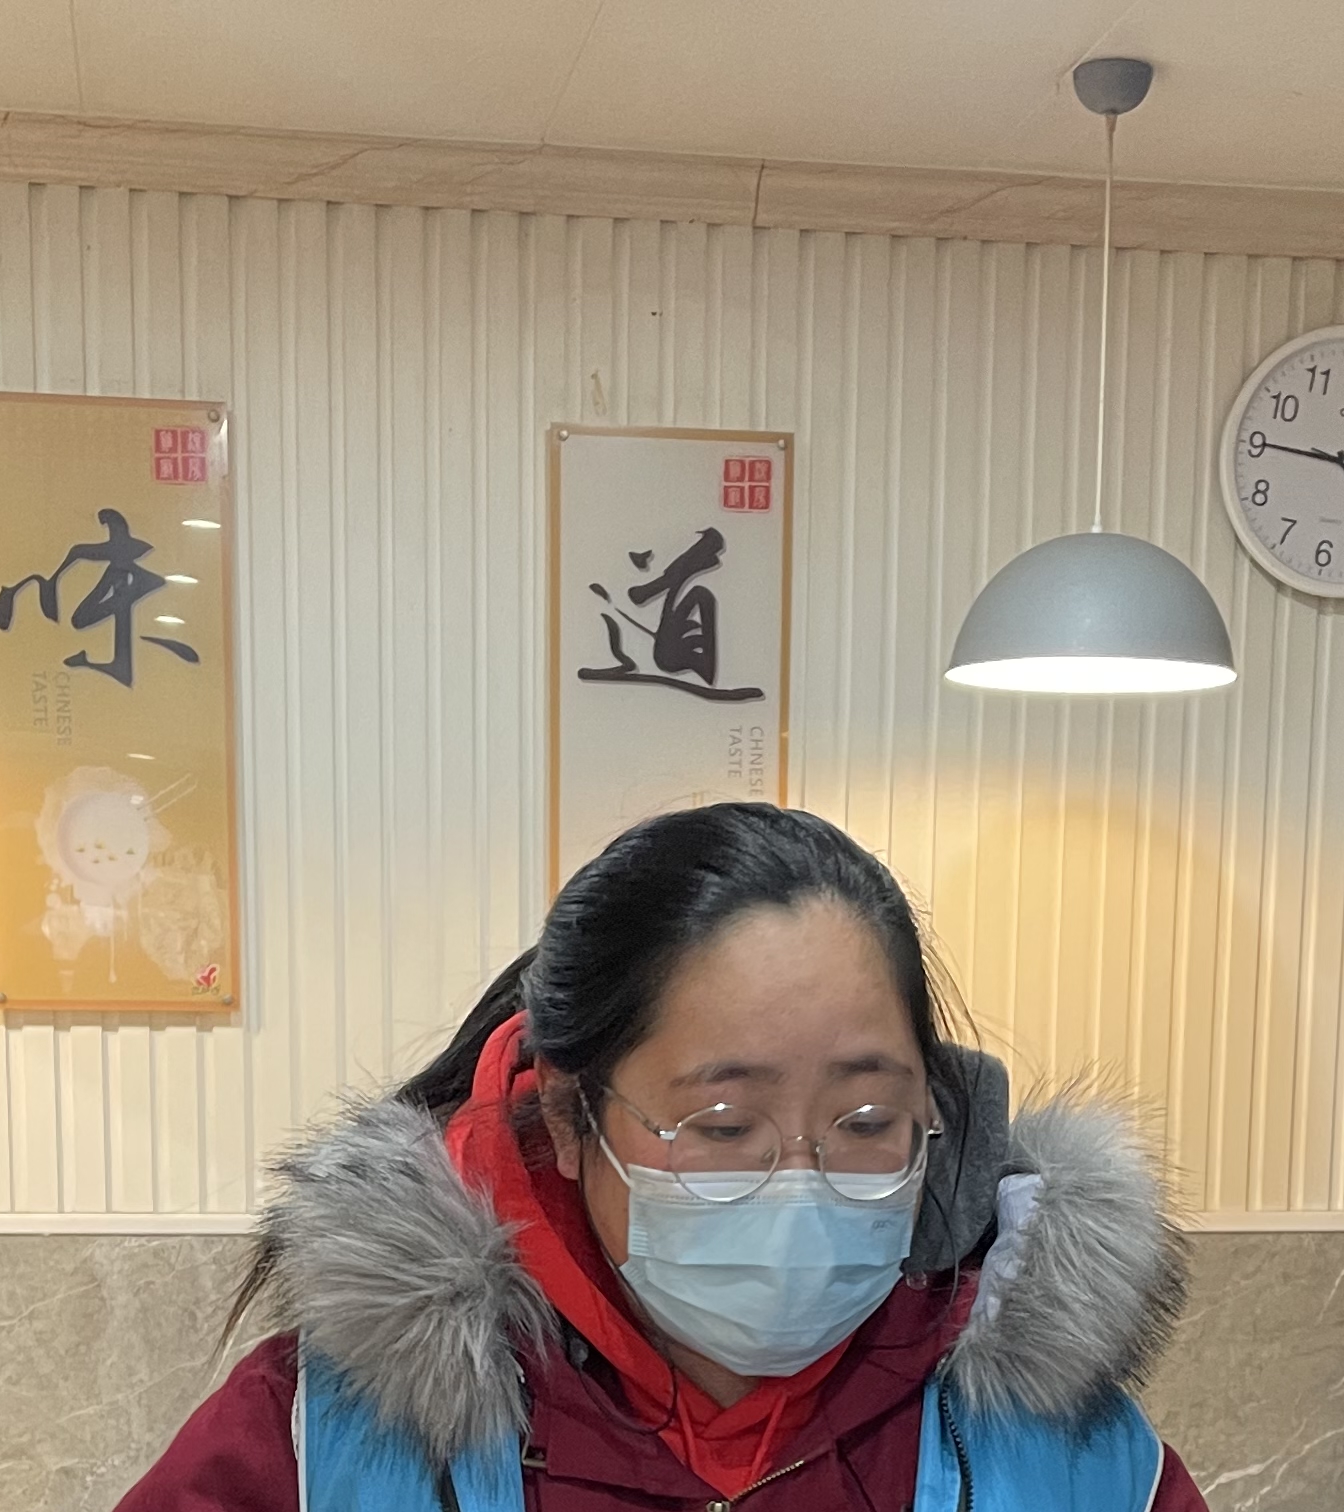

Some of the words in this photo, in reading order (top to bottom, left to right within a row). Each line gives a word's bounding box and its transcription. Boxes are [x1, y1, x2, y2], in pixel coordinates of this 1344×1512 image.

[1306, 365, 1331, 395] 11
[1270, 391, 1299, 422] 10
[1247, 431, 1267, 458] 9
[1251, 479, 1270, 506] 8
[1280, 517, 1297, 545] 7
[1315, 540, 1333, 567] 6
[577, 527, 765, 702] 道
[32, 670, 49, 727] TASTE
[727, 725, 742, 778] TASTE
